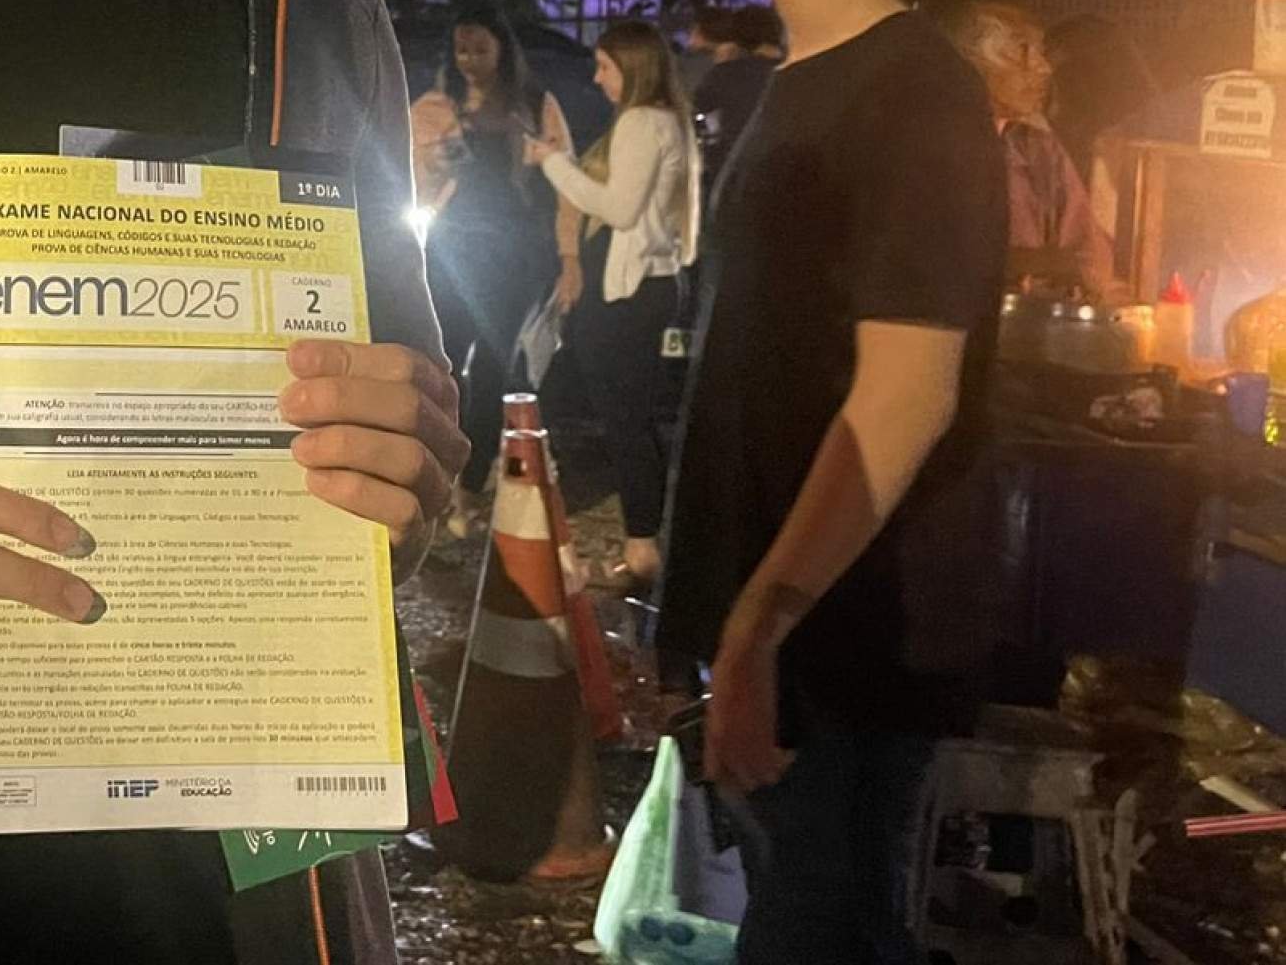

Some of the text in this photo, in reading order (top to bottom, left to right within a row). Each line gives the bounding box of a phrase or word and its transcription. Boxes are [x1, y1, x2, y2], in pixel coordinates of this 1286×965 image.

[10, 167, 16, 175] 2
[24, 166, 68, 175] AMARELO
[315, 185, 341, 199] DIA
[58, 205, 154, 223] NACIONAL
[161, 208, 187, 224] DO
[194, 211, 261, 228] ENSINO
[266, 211, 325, 233] MÉDIO
[31, 228, 44, 239] DE
[48, 229, 116, 241] LINGUAGENS,
[118, 229, 162, 242] CÓDIGOS
[165, 233, 171, 242] E
[173, 233, 198, 244] SUAS
[201, 235, 264, 247] TECNOLOGIAS
[266, 239, 271, 248] E
[273, 237, 316, 250] REDAÇÃO
[32, 242, 286, 262] PROVA DE CIÊNCIAS HUMANAS E SUAS TECNOLOGIAS
[291, 276, 332, 287] CADERNO
[306, 289, 322, 315] 2
[283, 317, 347, 334] AMARELO
[180, 785, 232, 798] EDUCAÇÃO
